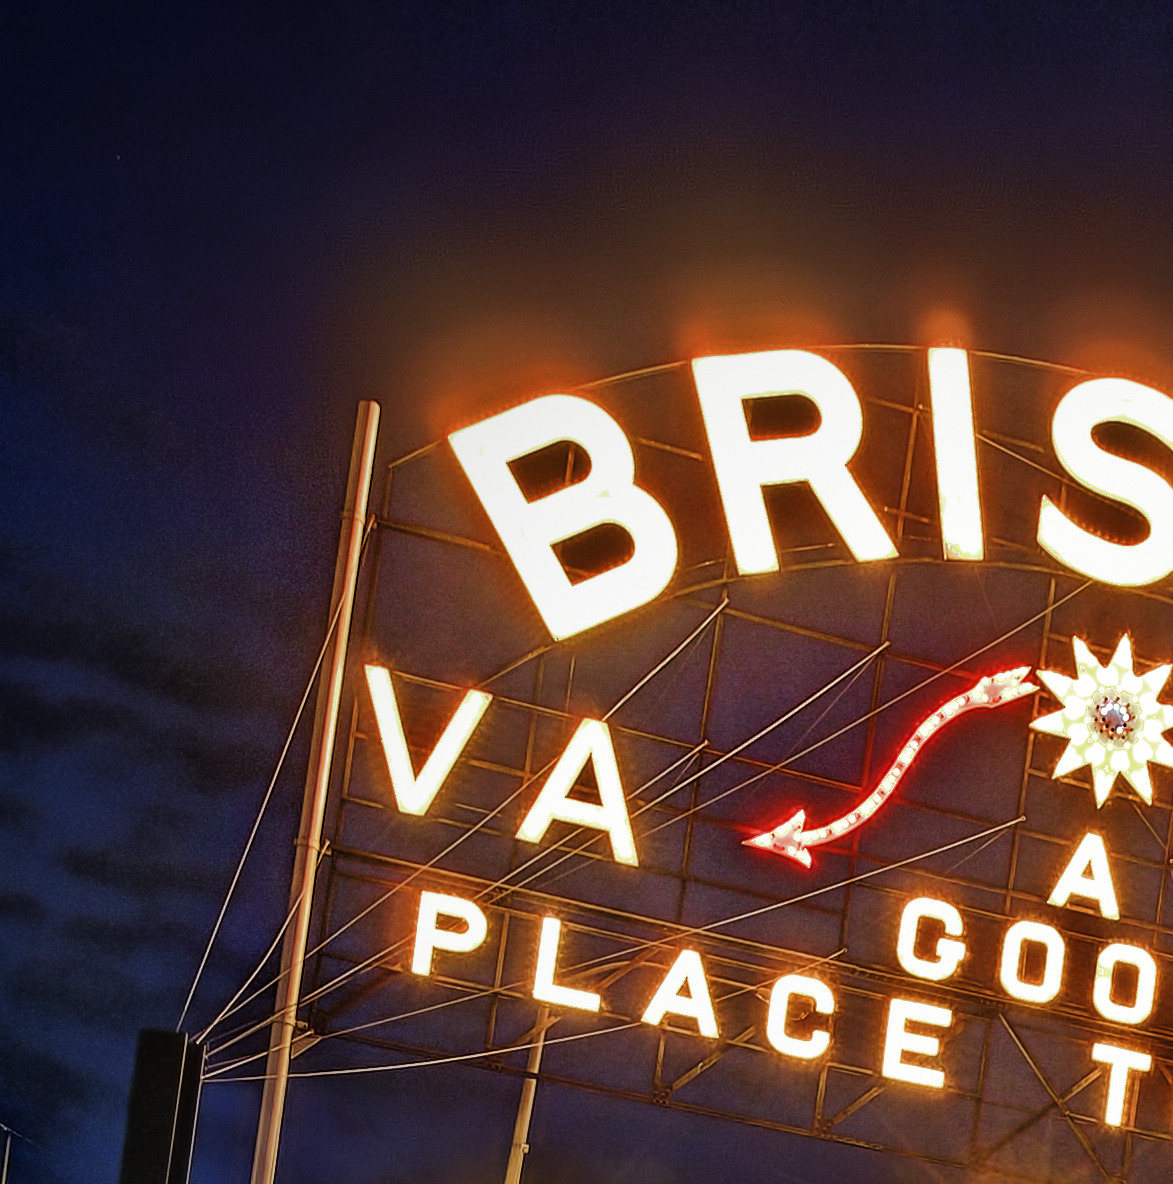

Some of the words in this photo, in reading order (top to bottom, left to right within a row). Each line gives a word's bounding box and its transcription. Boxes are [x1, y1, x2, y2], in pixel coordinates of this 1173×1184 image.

[364, 664, 639, 867] VA
[1047, 832, 1120, 920] A
[410, 890, 953, 1088] PLACE
